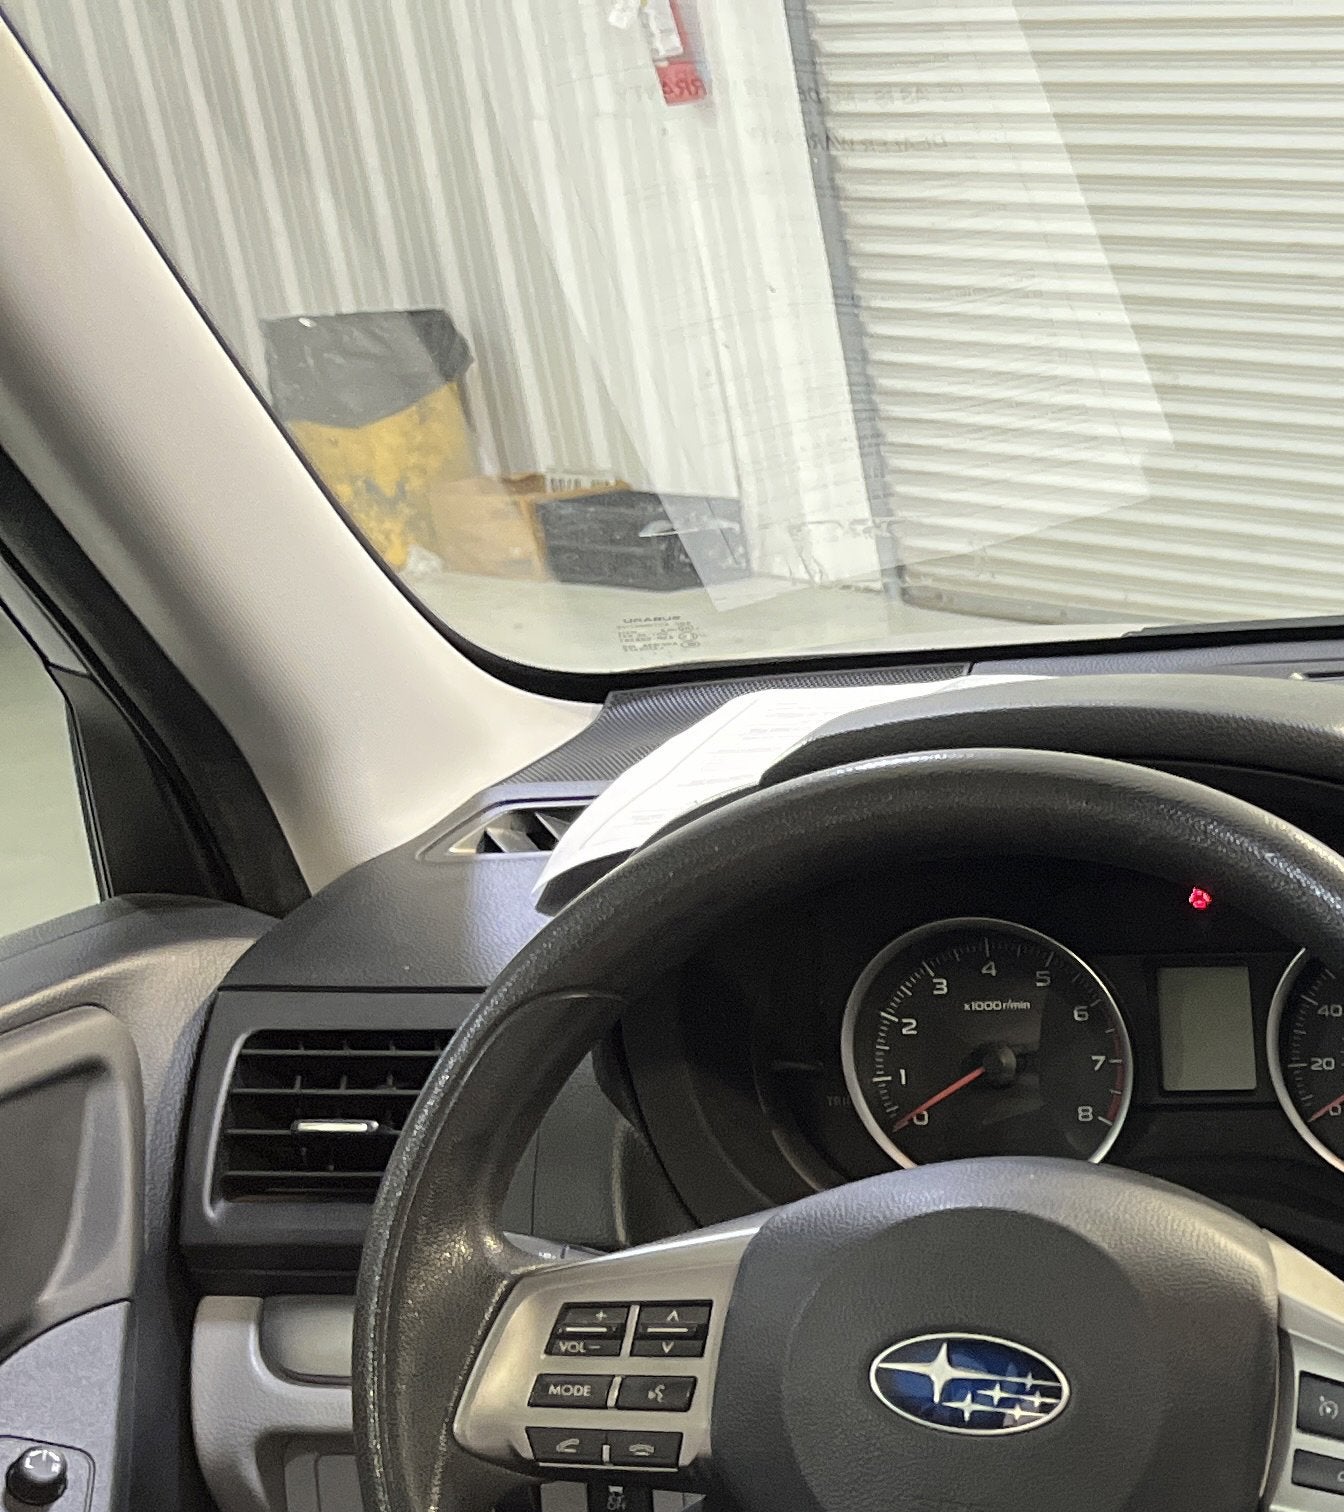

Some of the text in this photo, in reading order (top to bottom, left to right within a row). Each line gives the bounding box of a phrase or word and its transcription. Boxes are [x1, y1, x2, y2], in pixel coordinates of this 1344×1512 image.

[981, 961, 997, 977] 4
[932, 978, 948, 995] 3
[1035, 970, 1050, 987] 5
[1073, 1005, 1089, 1022] 6
[1317, 1004, 1343, 1017] 40
[901, 1018, 918, 1035] 2
[1091, 1055, 1106, 1071] 7
[1310, 1057, 1336, 1071] 20
[900, 1069, 907, 1085] 1
[913, 1110, 929, 1126] 0
[1077, 1105, 1093, 1122] 8
[1329, 1104, 1342, 1117] 0
[559, 1341, 587, 1353] VOL
[548, 1384, 592, 1397] MODE
